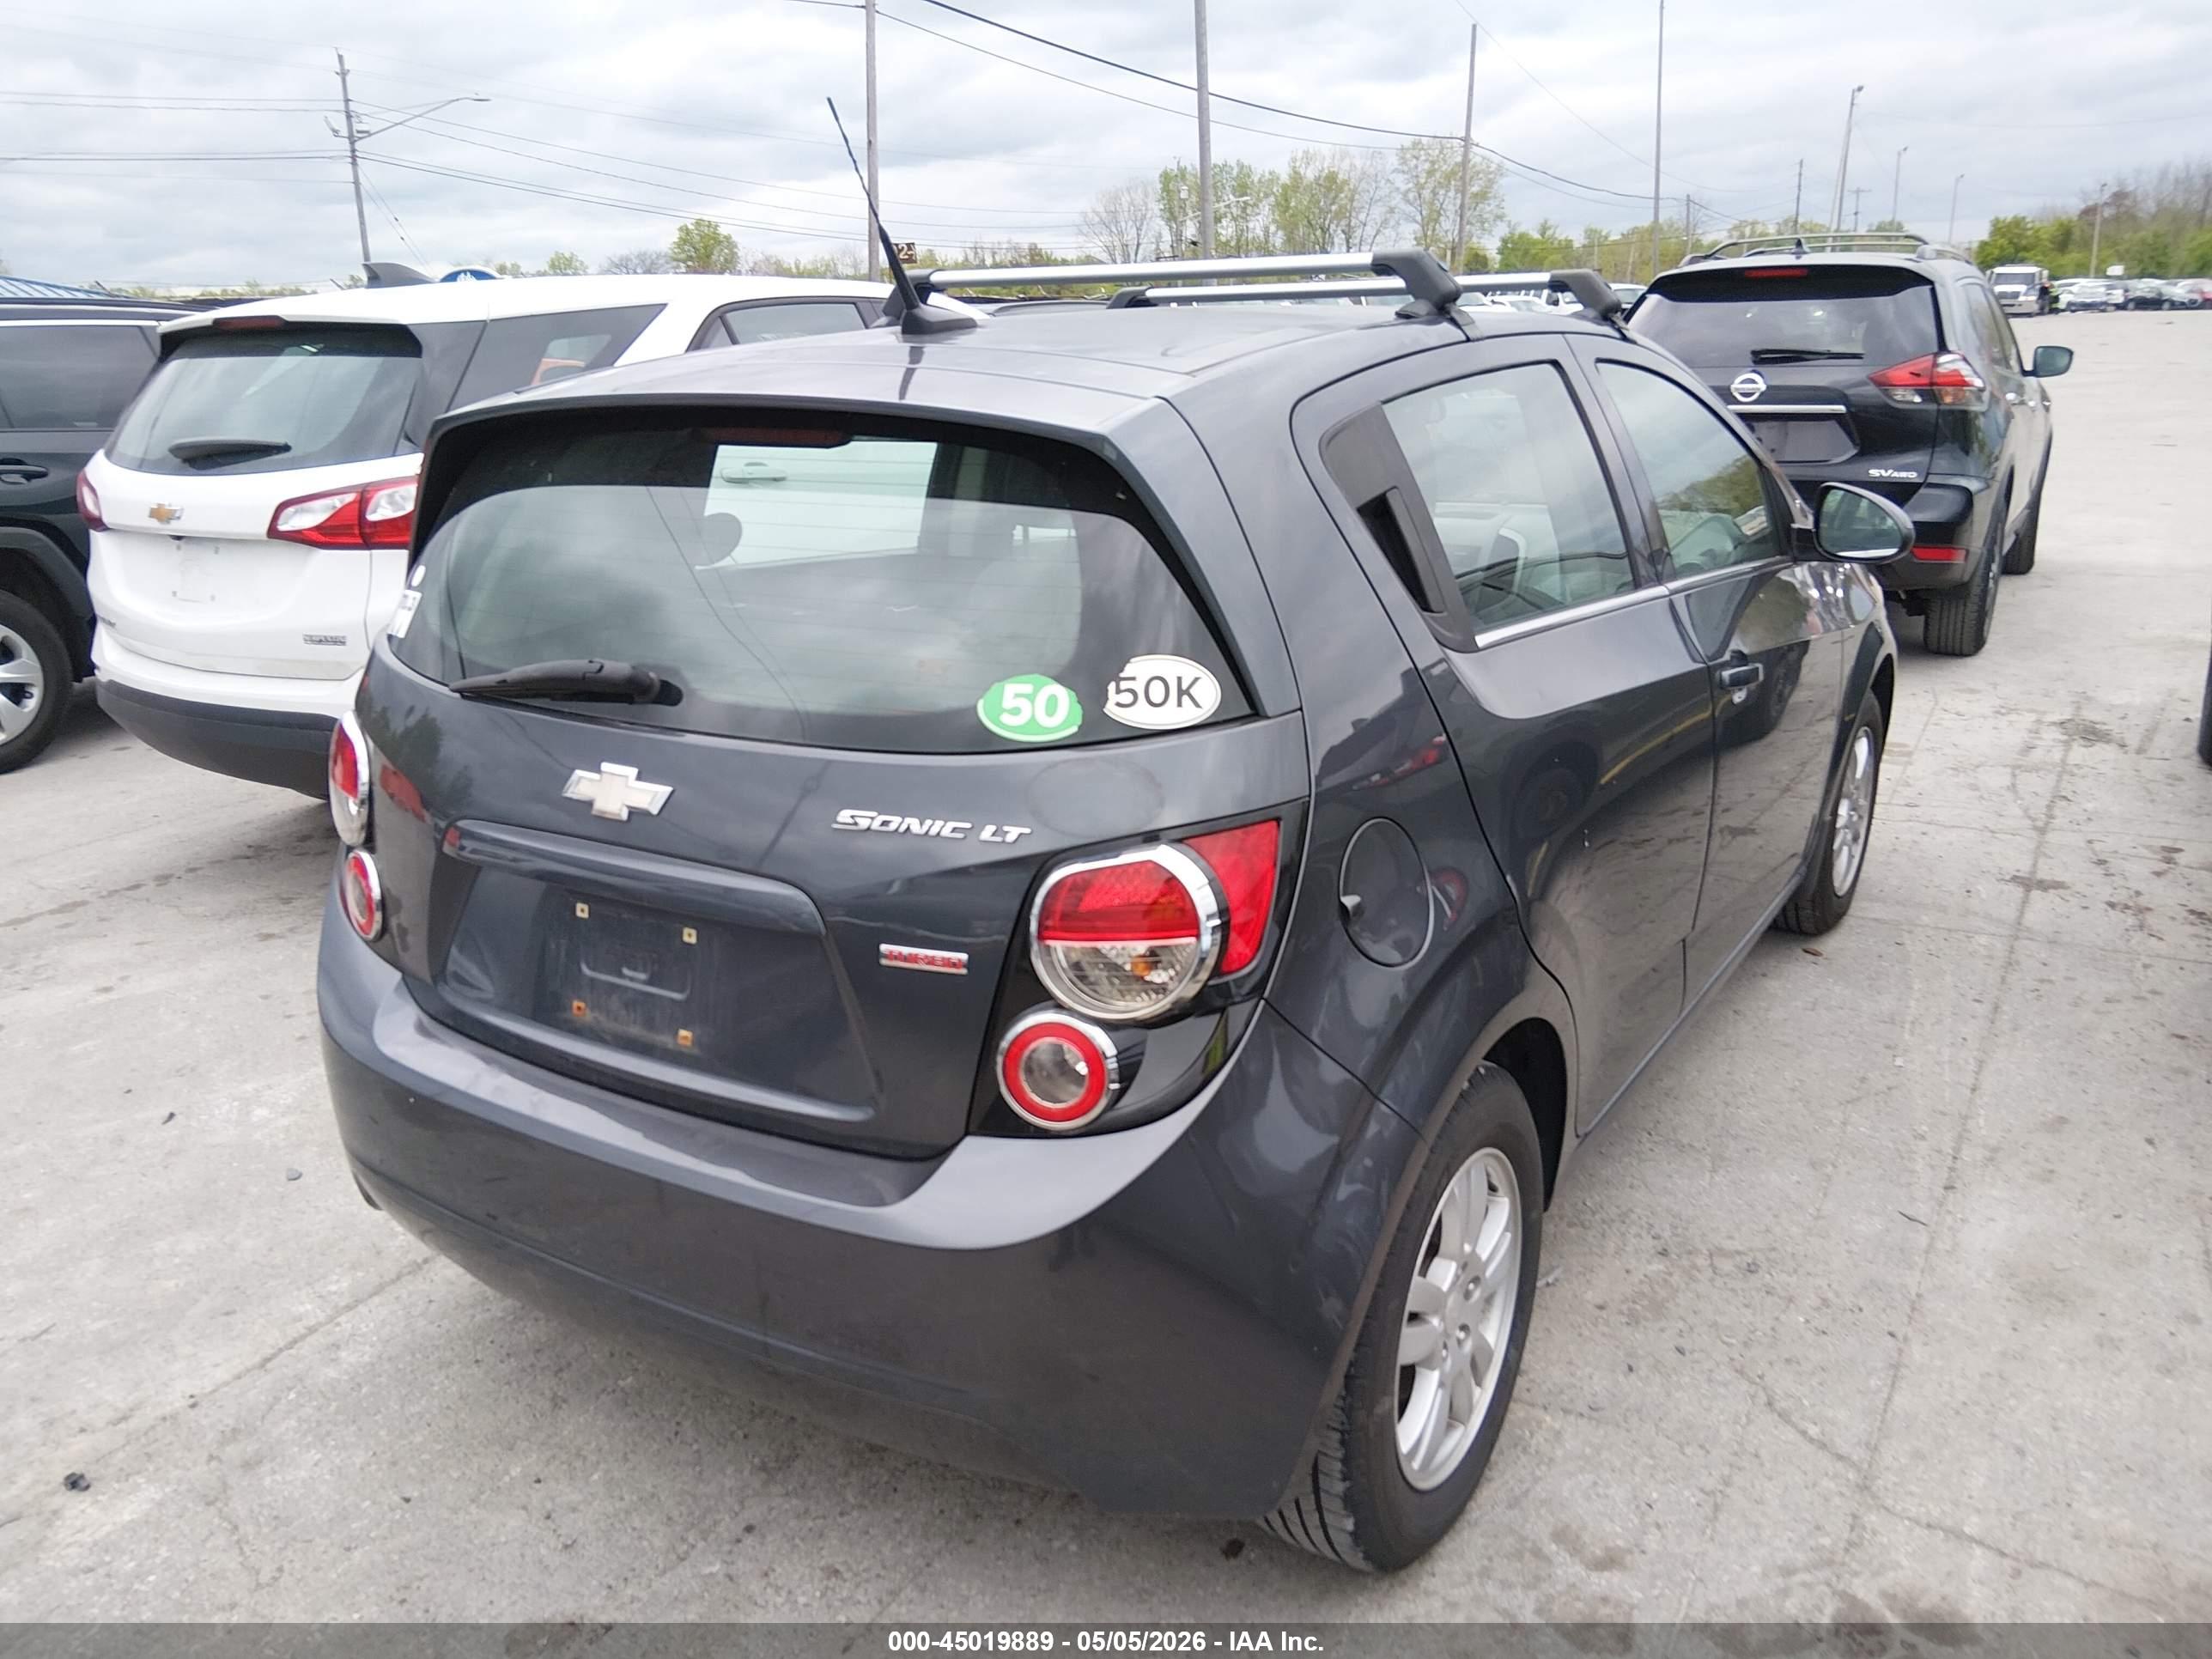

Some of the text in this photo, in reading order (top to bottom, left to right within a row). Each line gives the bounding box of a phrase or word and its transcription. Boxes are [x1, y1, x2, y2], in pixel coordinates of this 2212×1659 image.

[999, 683, 1070, 728] 50
[1114, 675, 1203, 709] 50K
[830, 808, 1032, 843] SONIC LT
